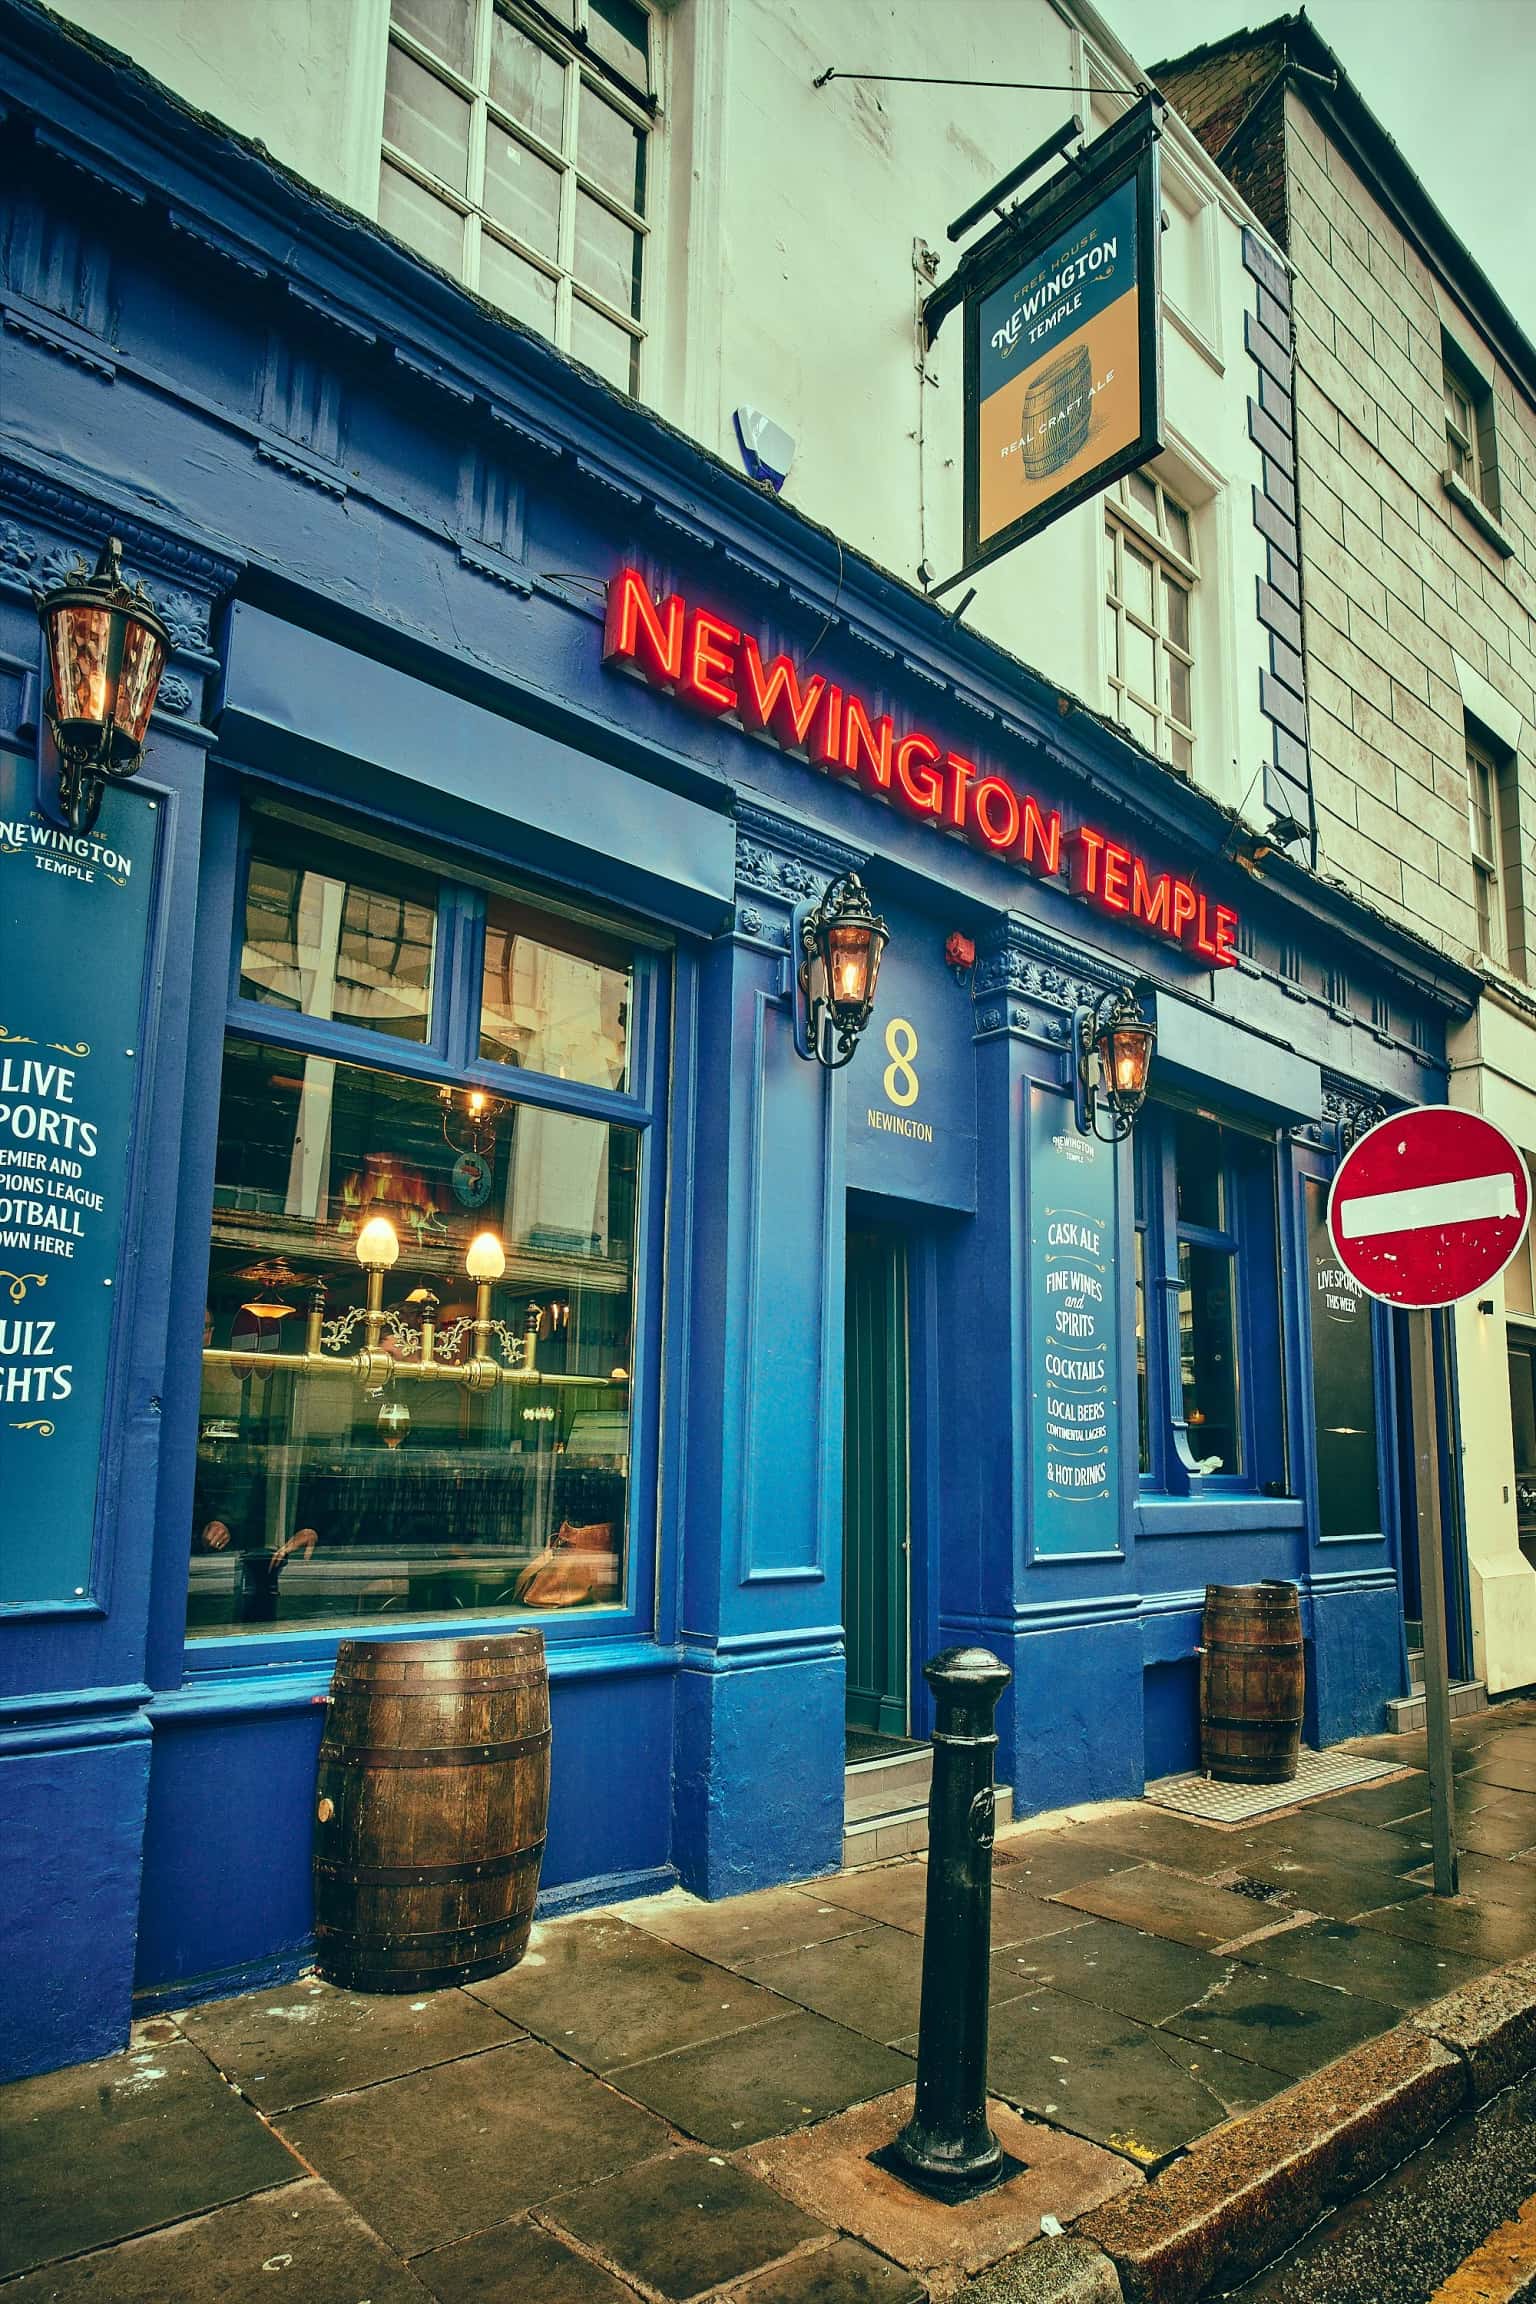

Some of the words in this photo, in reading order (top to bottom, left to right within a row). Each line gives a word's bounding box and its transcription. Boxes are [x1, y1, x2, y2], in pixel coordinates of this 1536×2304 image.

[1013, 269, 1046, 303] FREE
[1051, 228, 1098, 272] HOUSE
[991, 236, 1118, 350] NEWINGTON
[1028, 292, 1083, 345] TEMPLE
[1000, 433, 1035, 459] REAL
[1038, 396, 1084, 434] CRAFT
[1087, 368, 1117, 400] ALE
[609, 567, 1061, 876] NEWINGTON
[1077, 826, 1237, 967] TEMPLE
[0, 820, 132, 877] NEWINGTON
[34, 855, 95, 883] TEMPLE
[883, 1018, 919, 1107] 8
[1, 1058, 75, 1104] LIVE
[867, 1109, 933, 1143] NEWINGTON
[1052, 1135, 1095, 1159] NEWINGTON
[0, 1149, 47, 1171] EMIER
[49, 1156, 83, 1179] AND
[47, 1179, 104, 1212] LEAGUE
[0, 1198, 85, 1238] OTBALL
[34, 1234, 75, 1258] HERE
[1048, 1223, 1078, 1246] CASK
[1079, 1227, 1100, 1256] ALE
[1046, 1271, 1069, 1294] FINE
[1070, 1271, 1103, 1302] WINES
[1317, 1270, 1334, 1290] LIVE
[1064, 1294, 1085, 1309] and
[1325, 1294, 1340, 1310] THIS
[1339, 1297, 1357, 1313] WEEK
[0, 1319, 56, 1356] UIZ
[1055, 1310, 1095, 1337] SPIRITS
[0, 1364, 73, 1402] HTS
[1045, 1354, 1105, 1381] COCKTAILS
[1047, 1397, 1076, 1421] LOCAL
[1077, 1401, 1105, 1421] BEERS
[1046, 1422, 1085, 1441] CONTINENTAL
[1085, 1425, 1107, 1441] LAGERS
[1047, 1462, 1054, 1481] &
[1055, 1464, 1073, 1486] HOT
[1074, 1462, 1106, 1487] DRINKS
